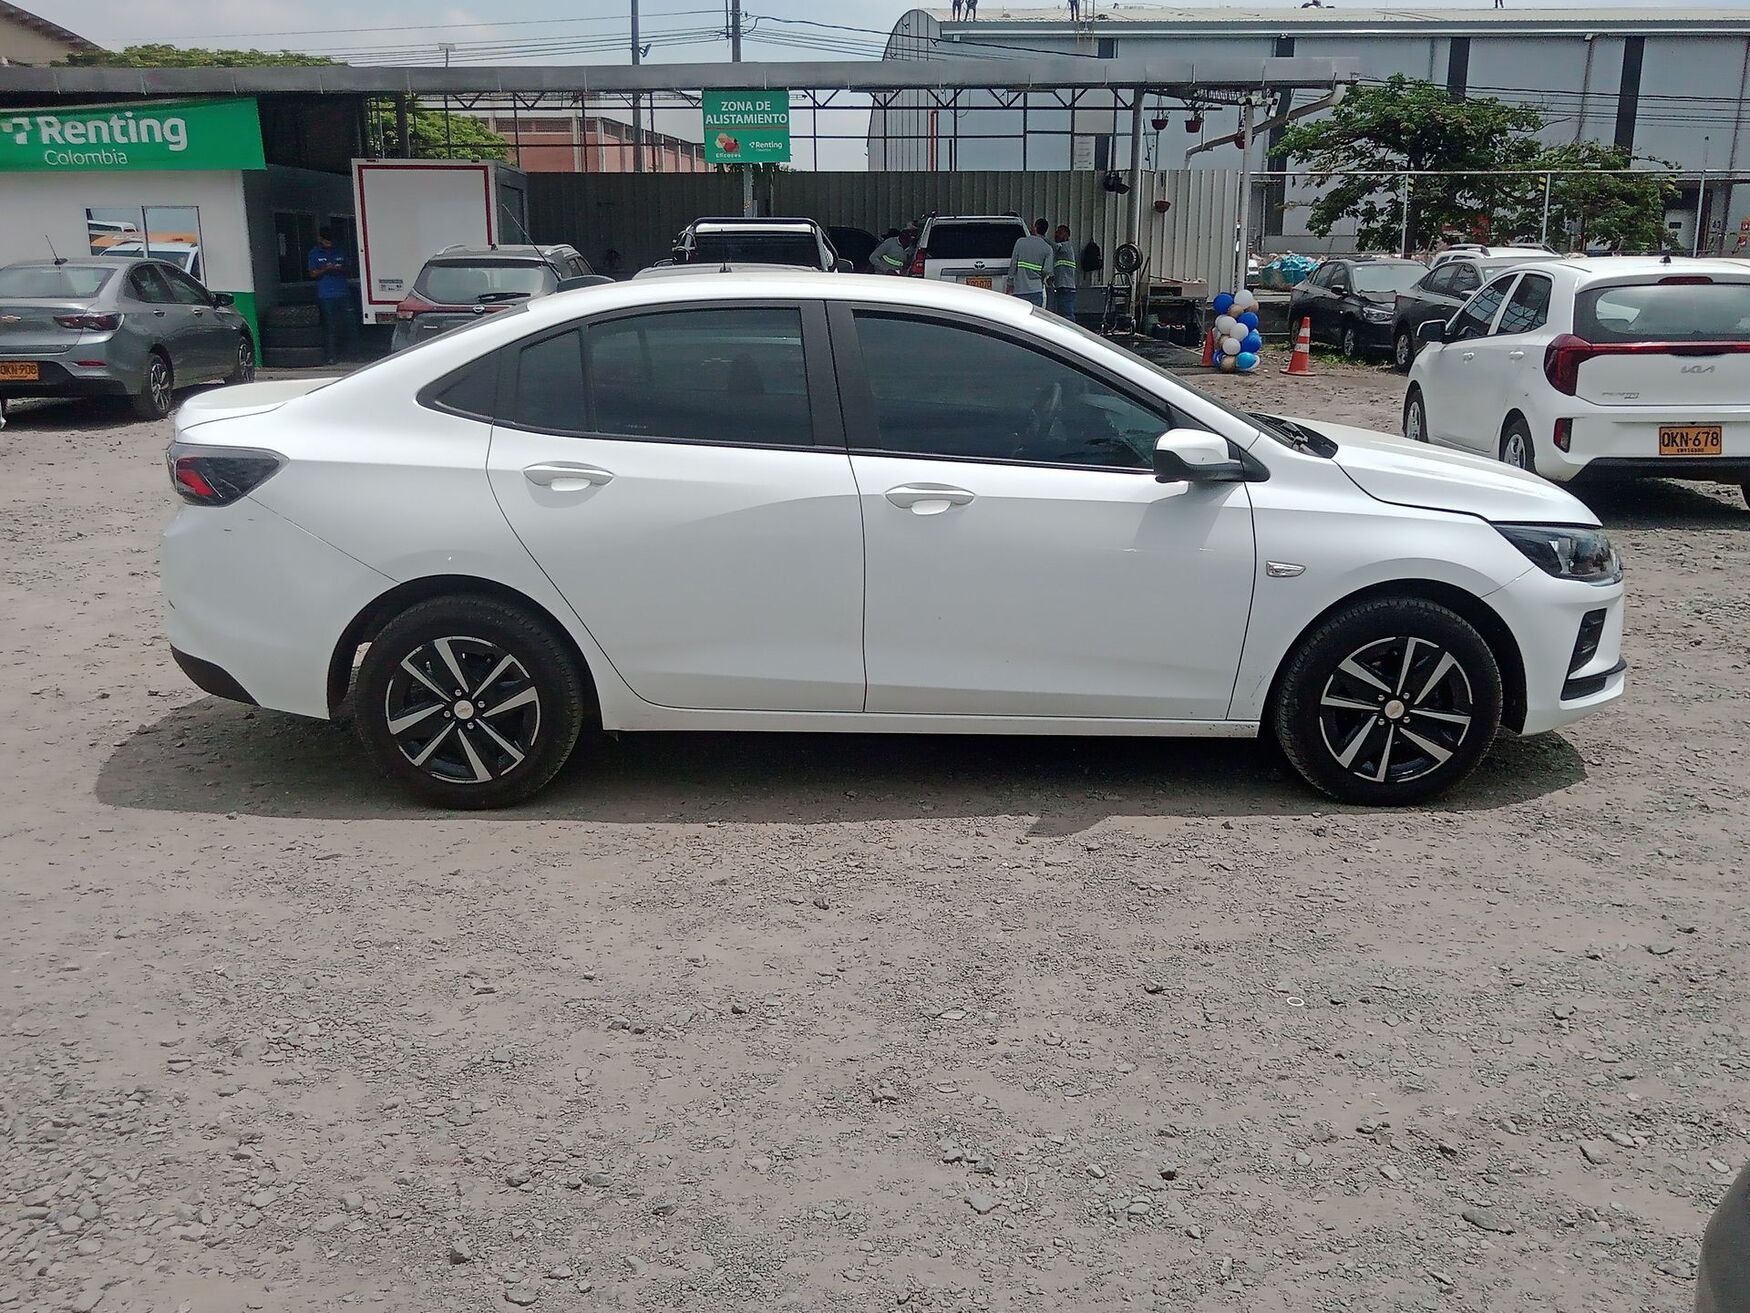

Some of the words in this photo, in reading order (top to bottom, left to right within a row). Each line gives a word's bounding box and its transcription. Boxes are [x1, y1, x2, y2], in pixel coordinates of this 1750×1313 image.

[721, 101, 753, 111] ZONA
[756, 101, 771, 111] DE
[706, 114, 788, 124] ALISTAMIENTO
[35, 111, 188, 151] Renting
[755, 141, 783, 149] Renting
[44, 149, 128, 165] Colombia
[1661, 431, 1719, 447] QKN-678
